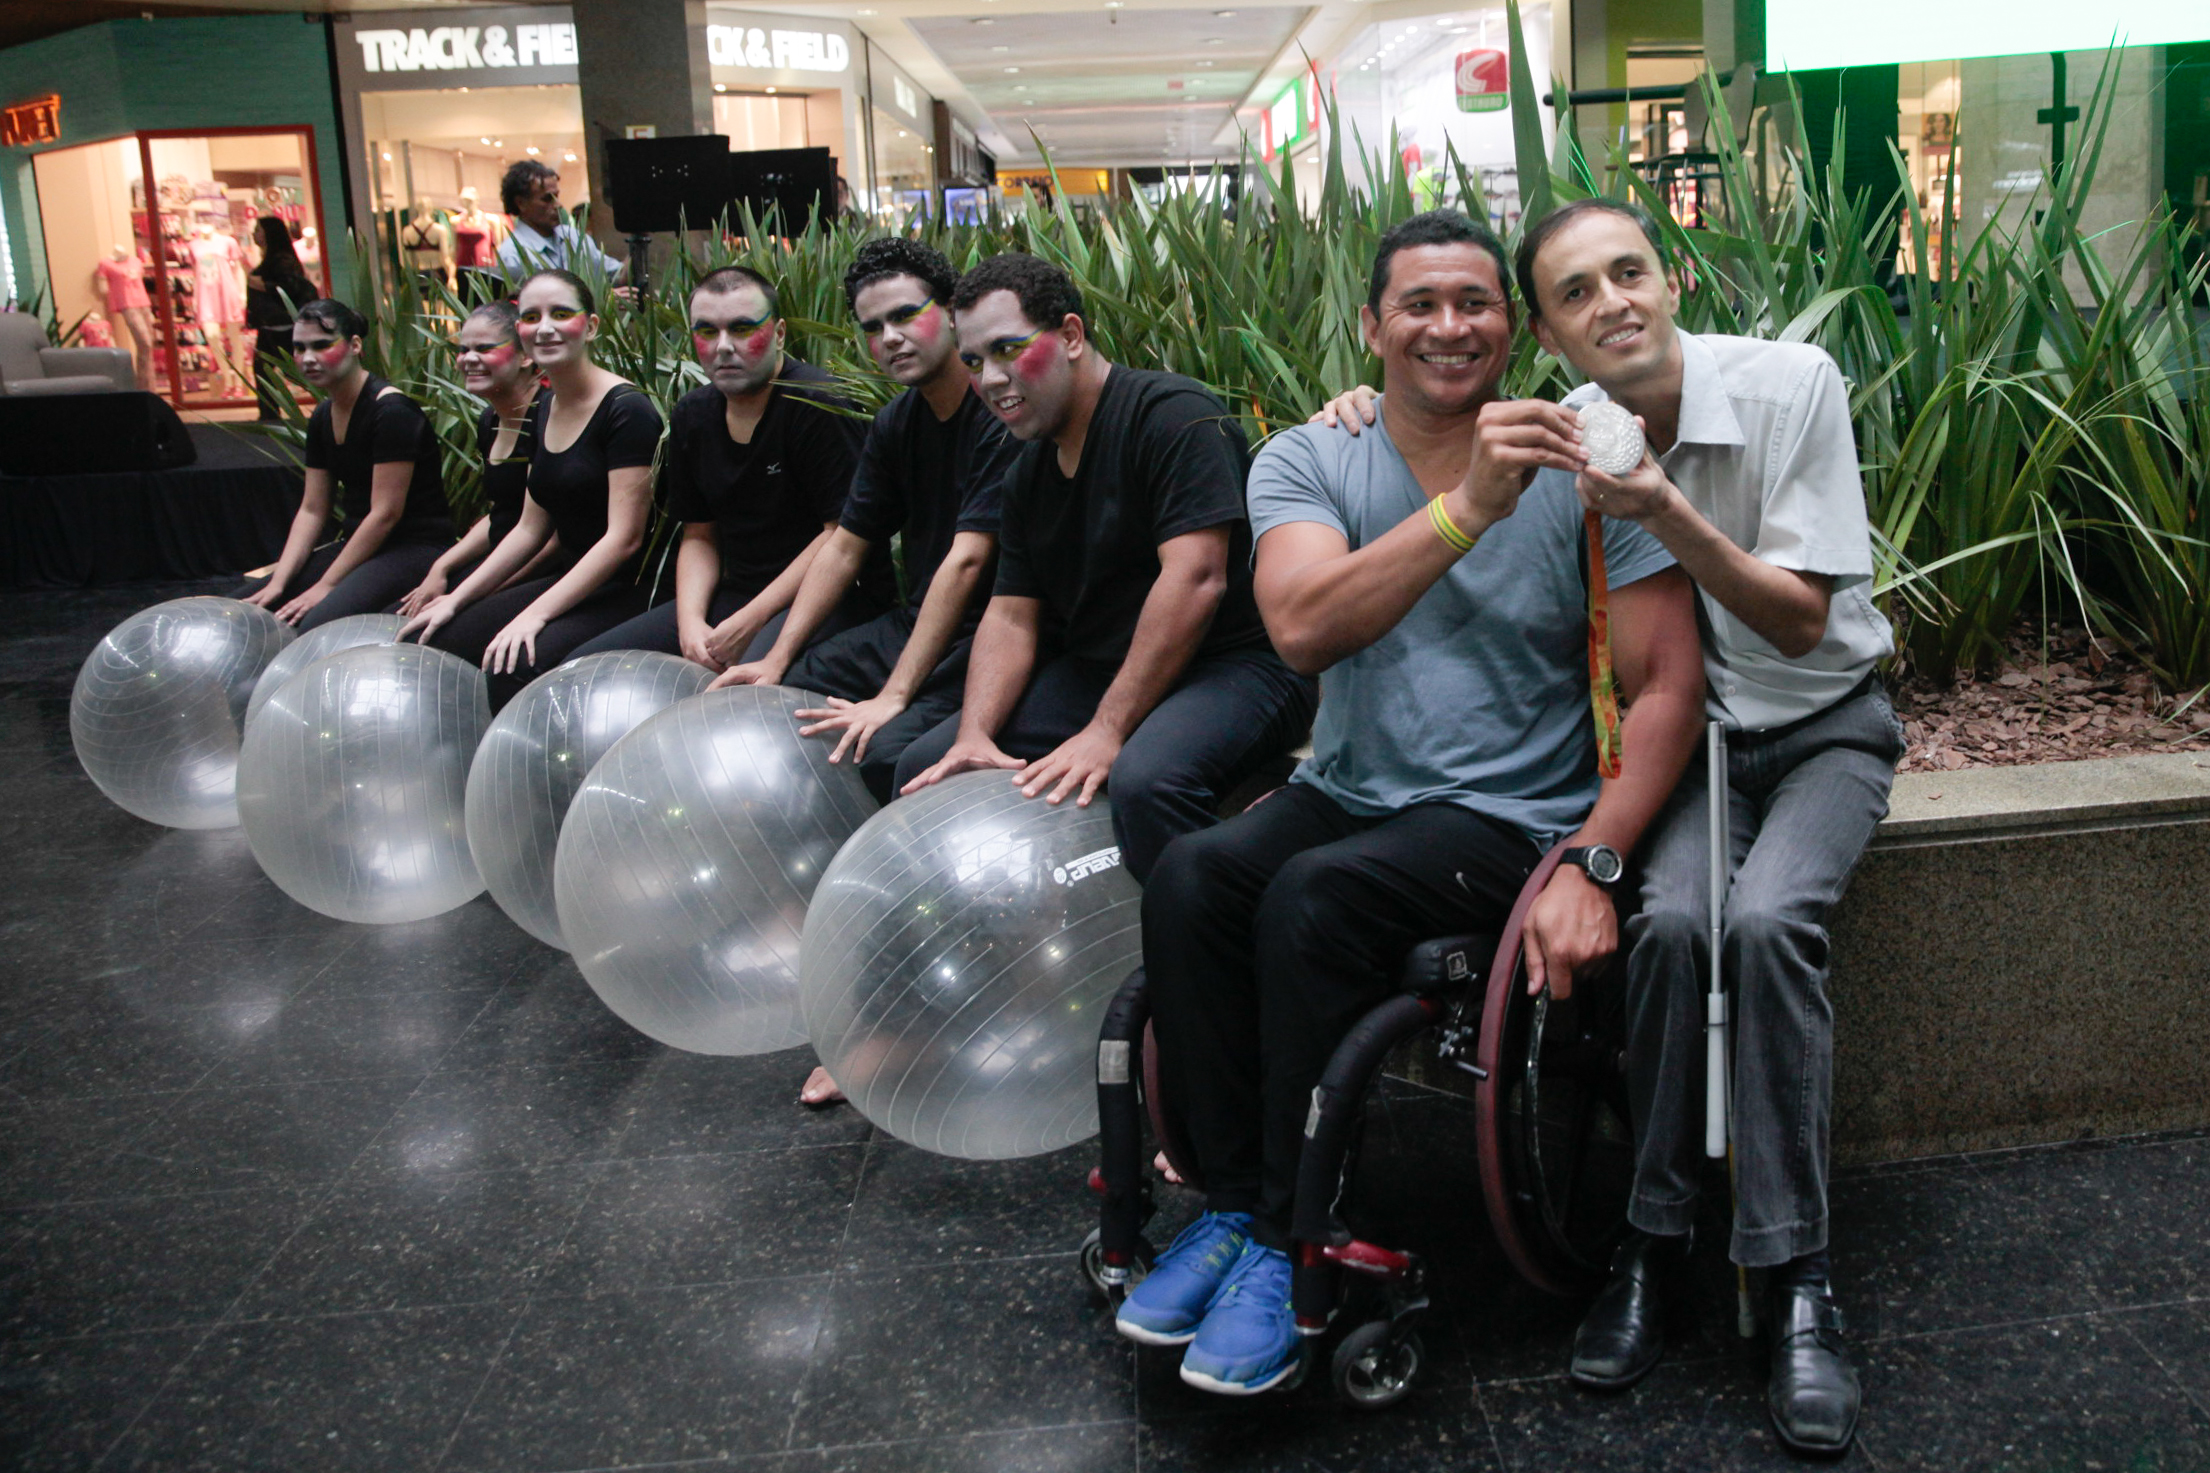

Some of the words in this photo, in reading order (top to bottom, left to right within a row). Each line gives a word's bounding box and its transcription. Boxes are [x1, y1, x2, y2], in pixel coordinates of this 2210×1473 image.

[355, 26, 485, 72] TRACK
[482, 24, 517, 68] &
[745, 28, 772, 68] &
[771, 29, 850, 72] FIELD
